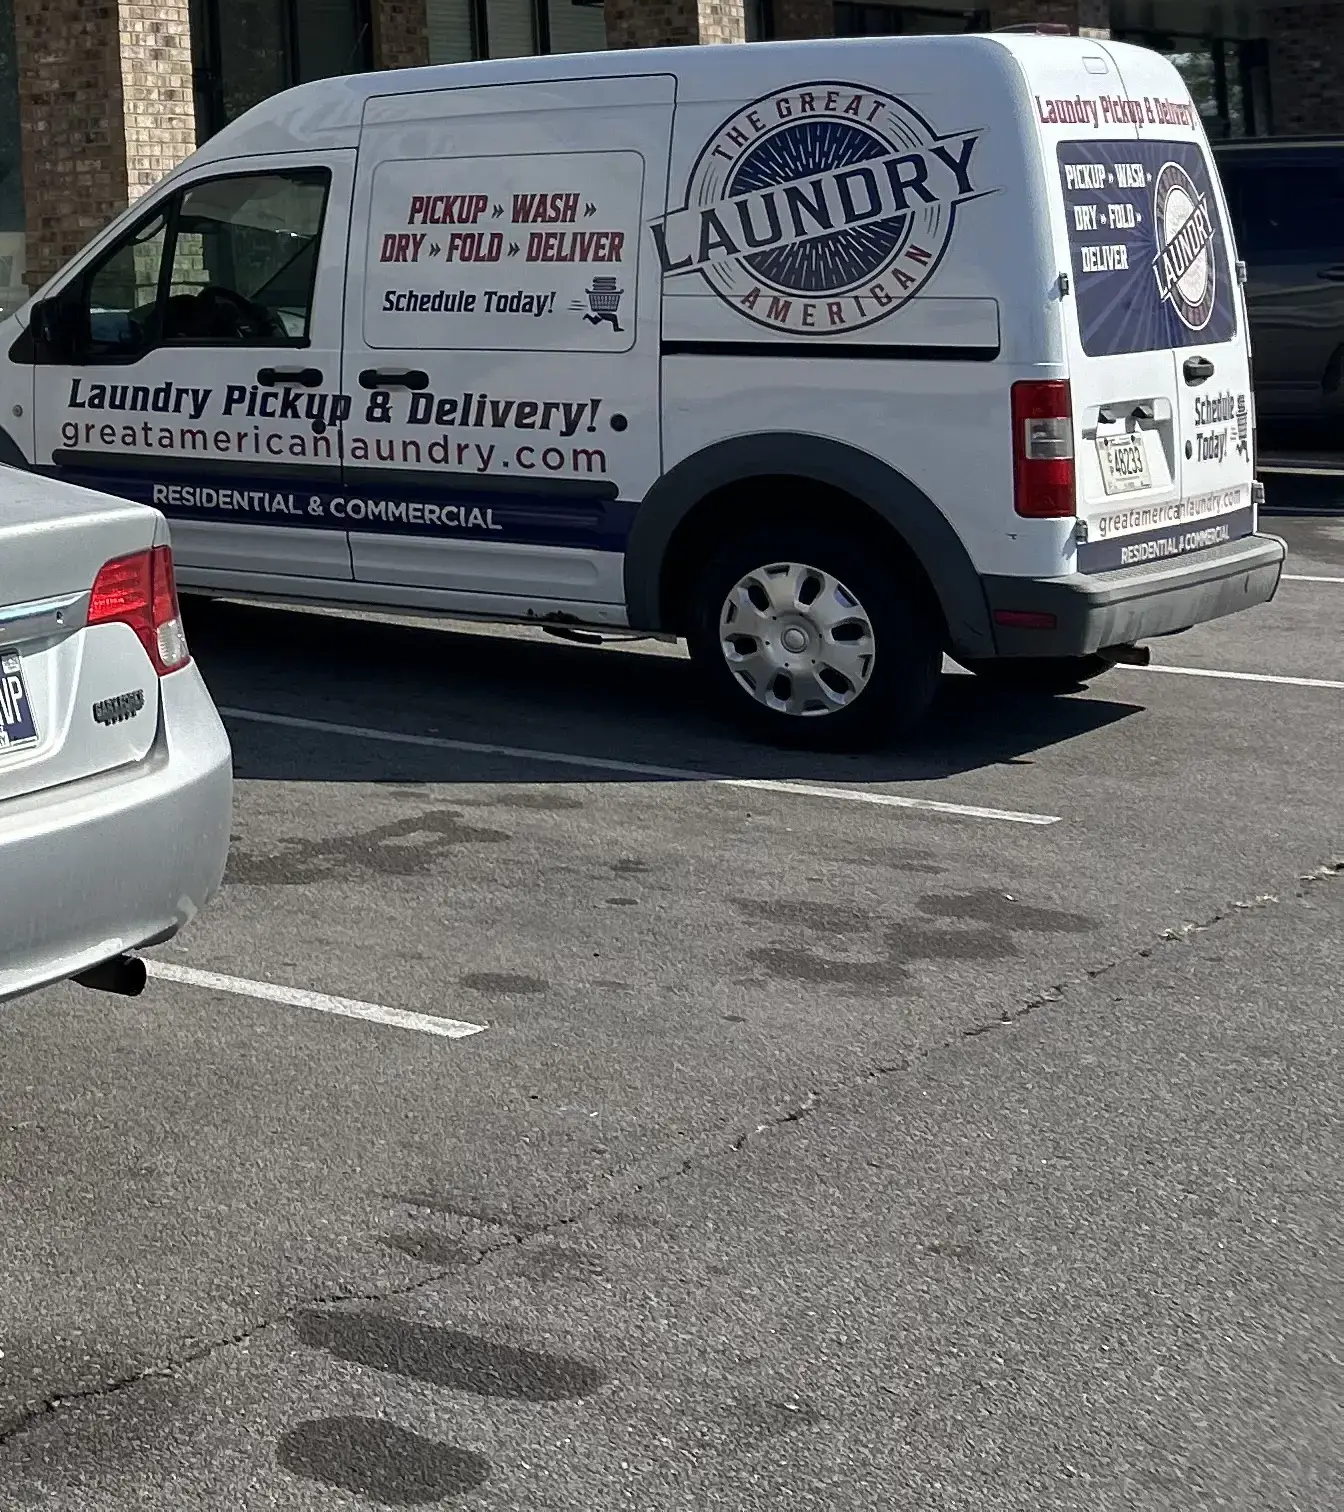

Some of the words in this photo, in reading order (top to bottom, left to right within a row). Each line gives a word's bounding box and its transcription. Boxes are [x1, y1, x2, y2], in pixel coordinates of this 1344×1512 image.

[711, 110, 766, 162] THE
[776, 91, 887, 123] GREAT
[1035, 94, 1099, 128] Laundry
[1099, 95, 1145, 128] Pickup
[1144, 96, 1155, 123] &
[1064, 163, 1106, 190] PICKUP
[1114, 163, 1146, 188] WASH
[408, 194, 489, 225] PICKUP
[511, 192, 580, 223] WASH
[649, 135, 980, 272] LAUNDRY
[1074, 204, 1098, 231] DRY
[1108, 203, 1136, 229] FOLD
[380, 233, 427, 263] DRY
[446, 232, 504, 263] FOLD
[525, 232, 625, 263] DELIVER
[1080, 244, 1129, 273] DELIVER
[1153, 197, 1213, 300] LAUNDRY
[383, 290, 475, 313] Schedule
[484, 290, 556, 317] Today!
[740, 243, 933, 328] AMERICAN
[68, 378, 213, 420] Laundry
[222, 384, 352, 427] Pickup
[366, 391, 393, 423] &
[407, 392, 602, 437] Delivery!
[1194, 389, 1234, 426] Schedule
[62, 421, 607, 473] greatamericanlaundry.com
[1196, 428, 1228, 464] Today!
[153, 484, 304, 515] RESIDENTIAL
[307, 495, 325, 517] &
[329, 497, 503, 531] COMMERCIAL
[1099, 489, 1241, 538] greatamericanlaundry.com
[1120, 536, 1178, 565] RESIDENTIAL
[1185, 524, 1230, 550] COMMERCIAL
